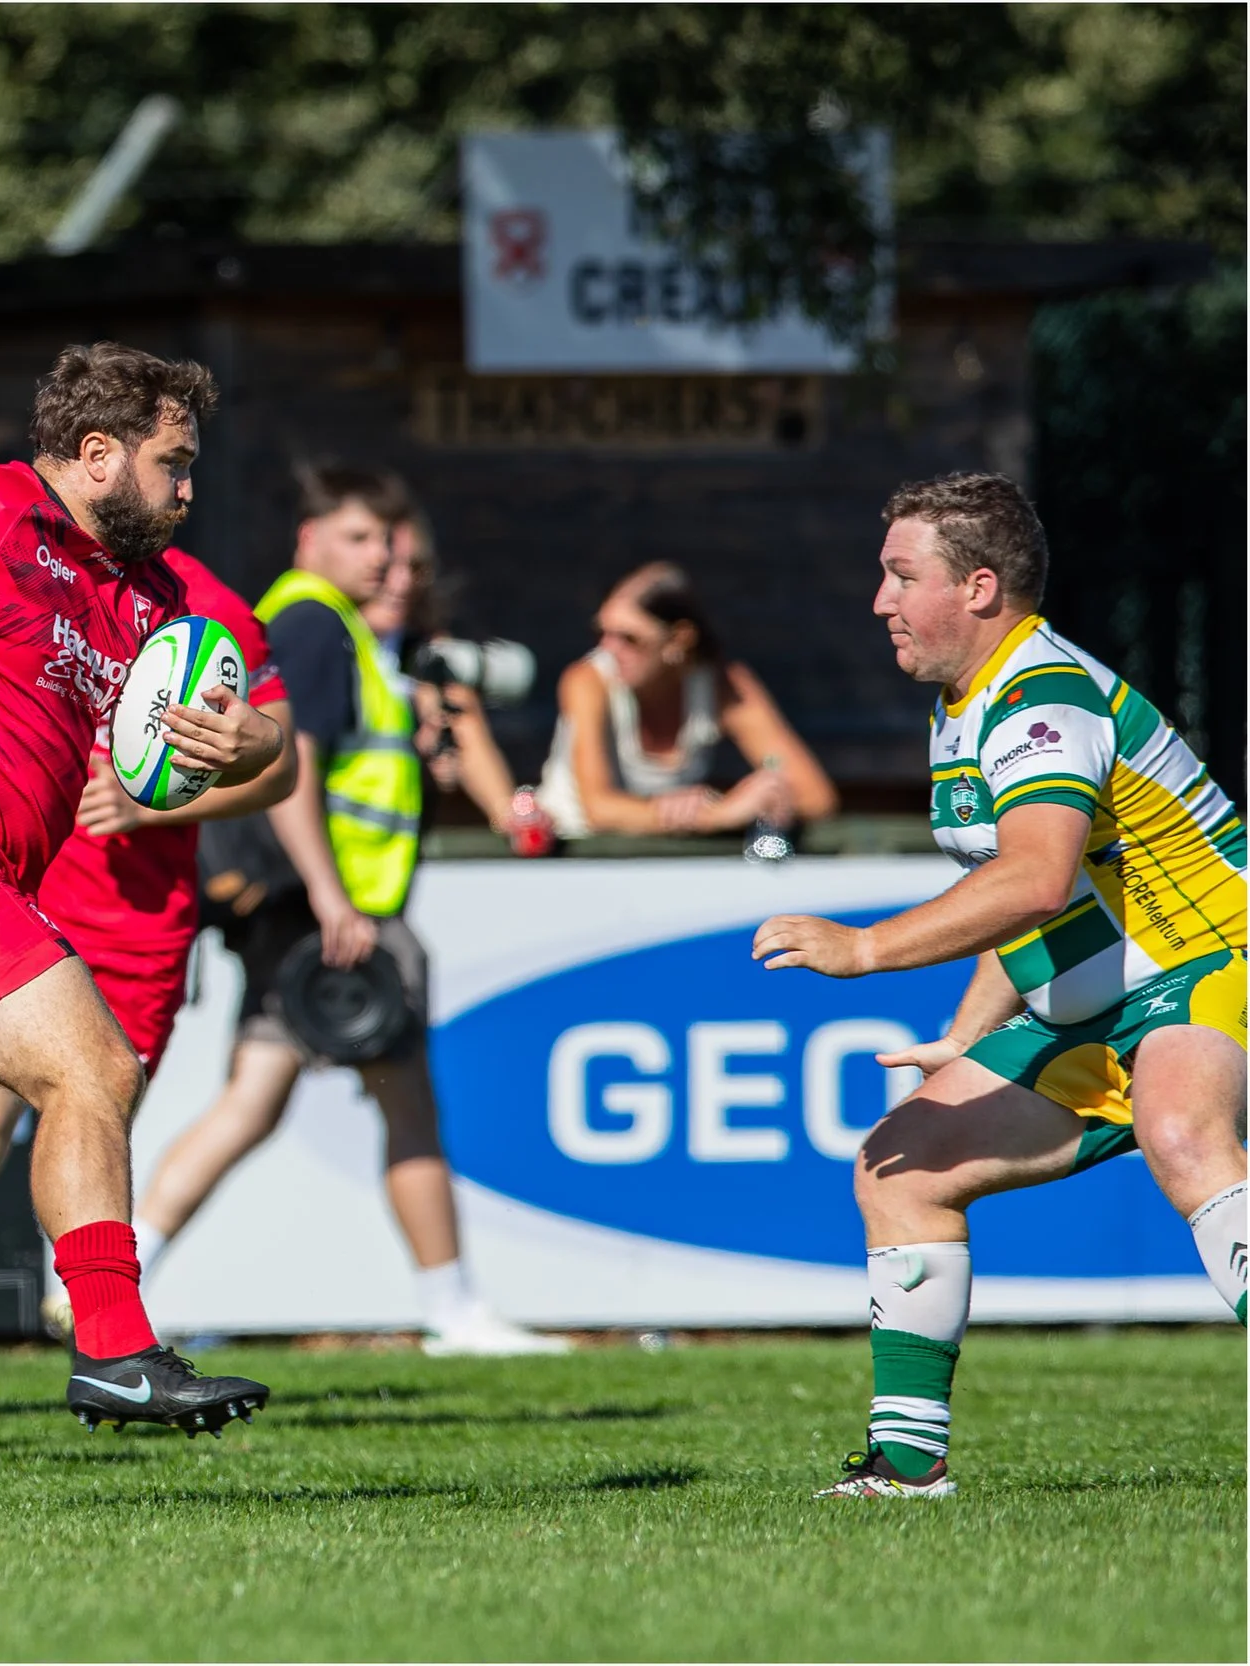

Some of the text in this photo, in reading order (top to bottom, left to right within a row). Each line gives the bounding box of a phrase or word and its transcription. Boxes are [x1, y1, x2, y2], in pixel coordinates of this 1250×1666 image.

[36, 544, 77, 584] Ogier
[36, 677, 68, 698] Building
[1108, 856, 1186, 951] MOOREMentum
[547, 1018, 922, 1165] GEO
